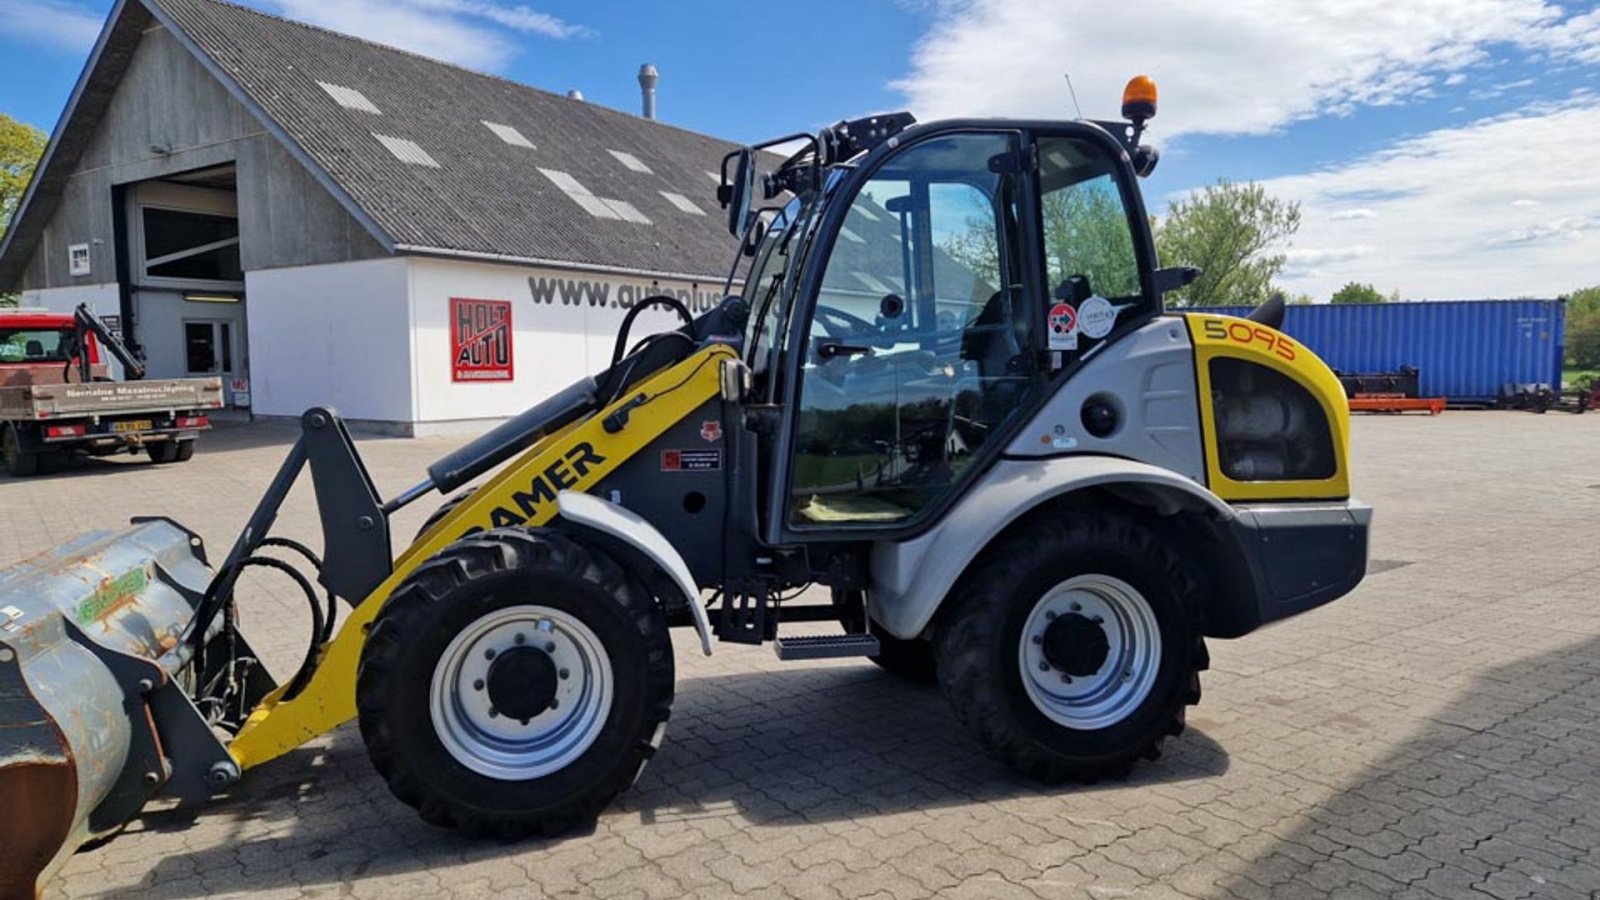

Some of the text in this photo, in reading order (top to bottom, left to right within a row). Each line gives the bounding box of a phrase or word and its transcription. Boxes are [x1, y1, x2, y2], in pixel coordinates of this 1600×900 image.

[458, 303, 506, 343] HOLT
[1204, 320, 1296, 361] 5095
[458, 324, 508, 365] AUTO
[456, 442, 607, 540] AMER
